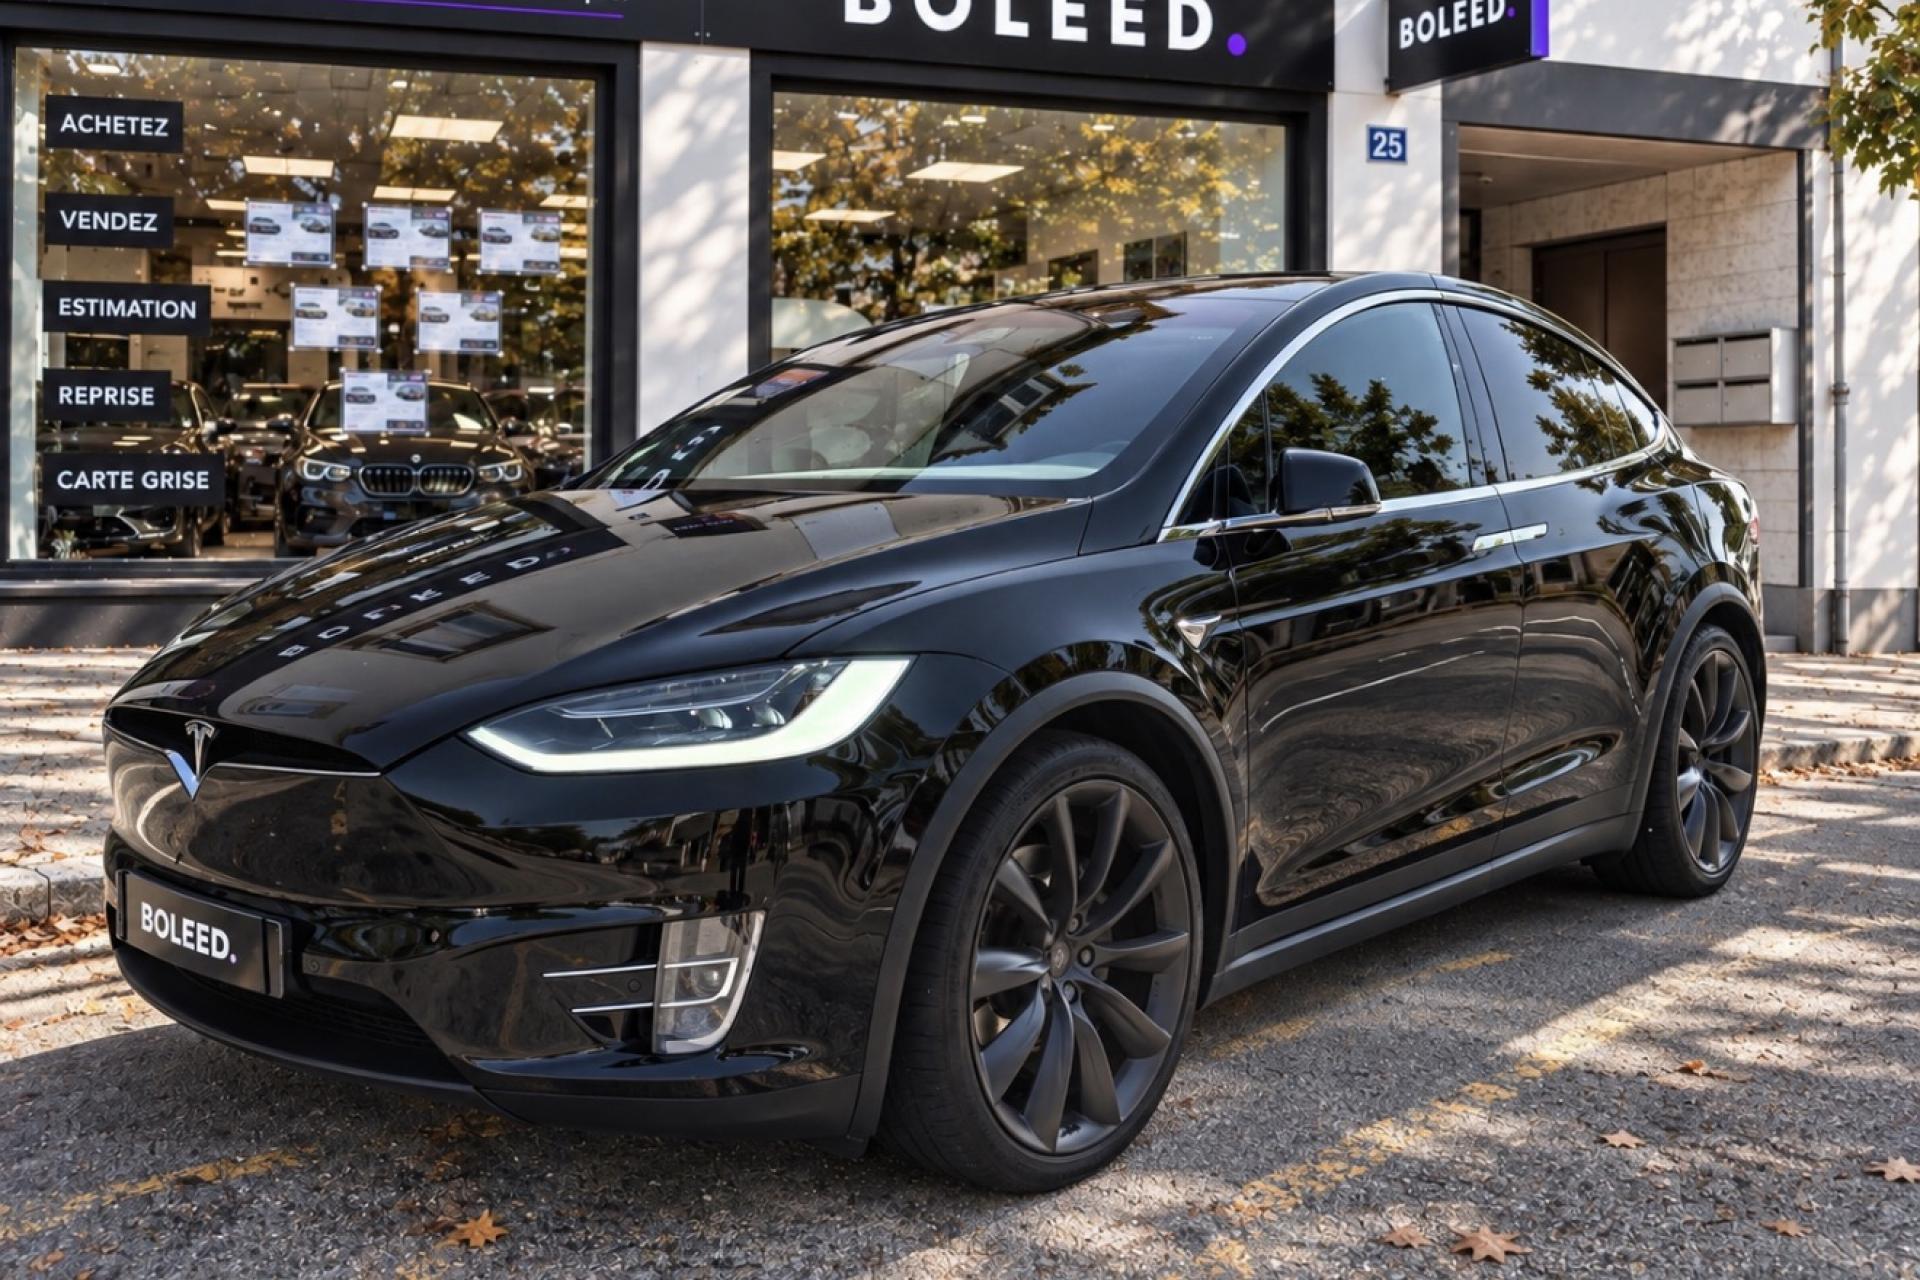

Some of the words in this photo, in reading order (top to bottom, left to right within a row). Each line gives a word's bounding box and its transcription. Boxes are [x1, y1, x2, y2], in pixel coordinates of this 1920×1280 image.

[1399, 0, 1517, 50] BOLEED.
[60, 113, 169, 137] ACHETEZ
[1372, 130, 1403, 159] 25
[60, 209, 158, 232] VENDEZ
[58, 297, 197, 320] ESTIMATION
[58, 385, 155, 406] REPRISE
[57, 470, 134, 490] CARTE
[141, 470, 210, 490] GRISE
[140, 901, 237, 964] BOLEED.
